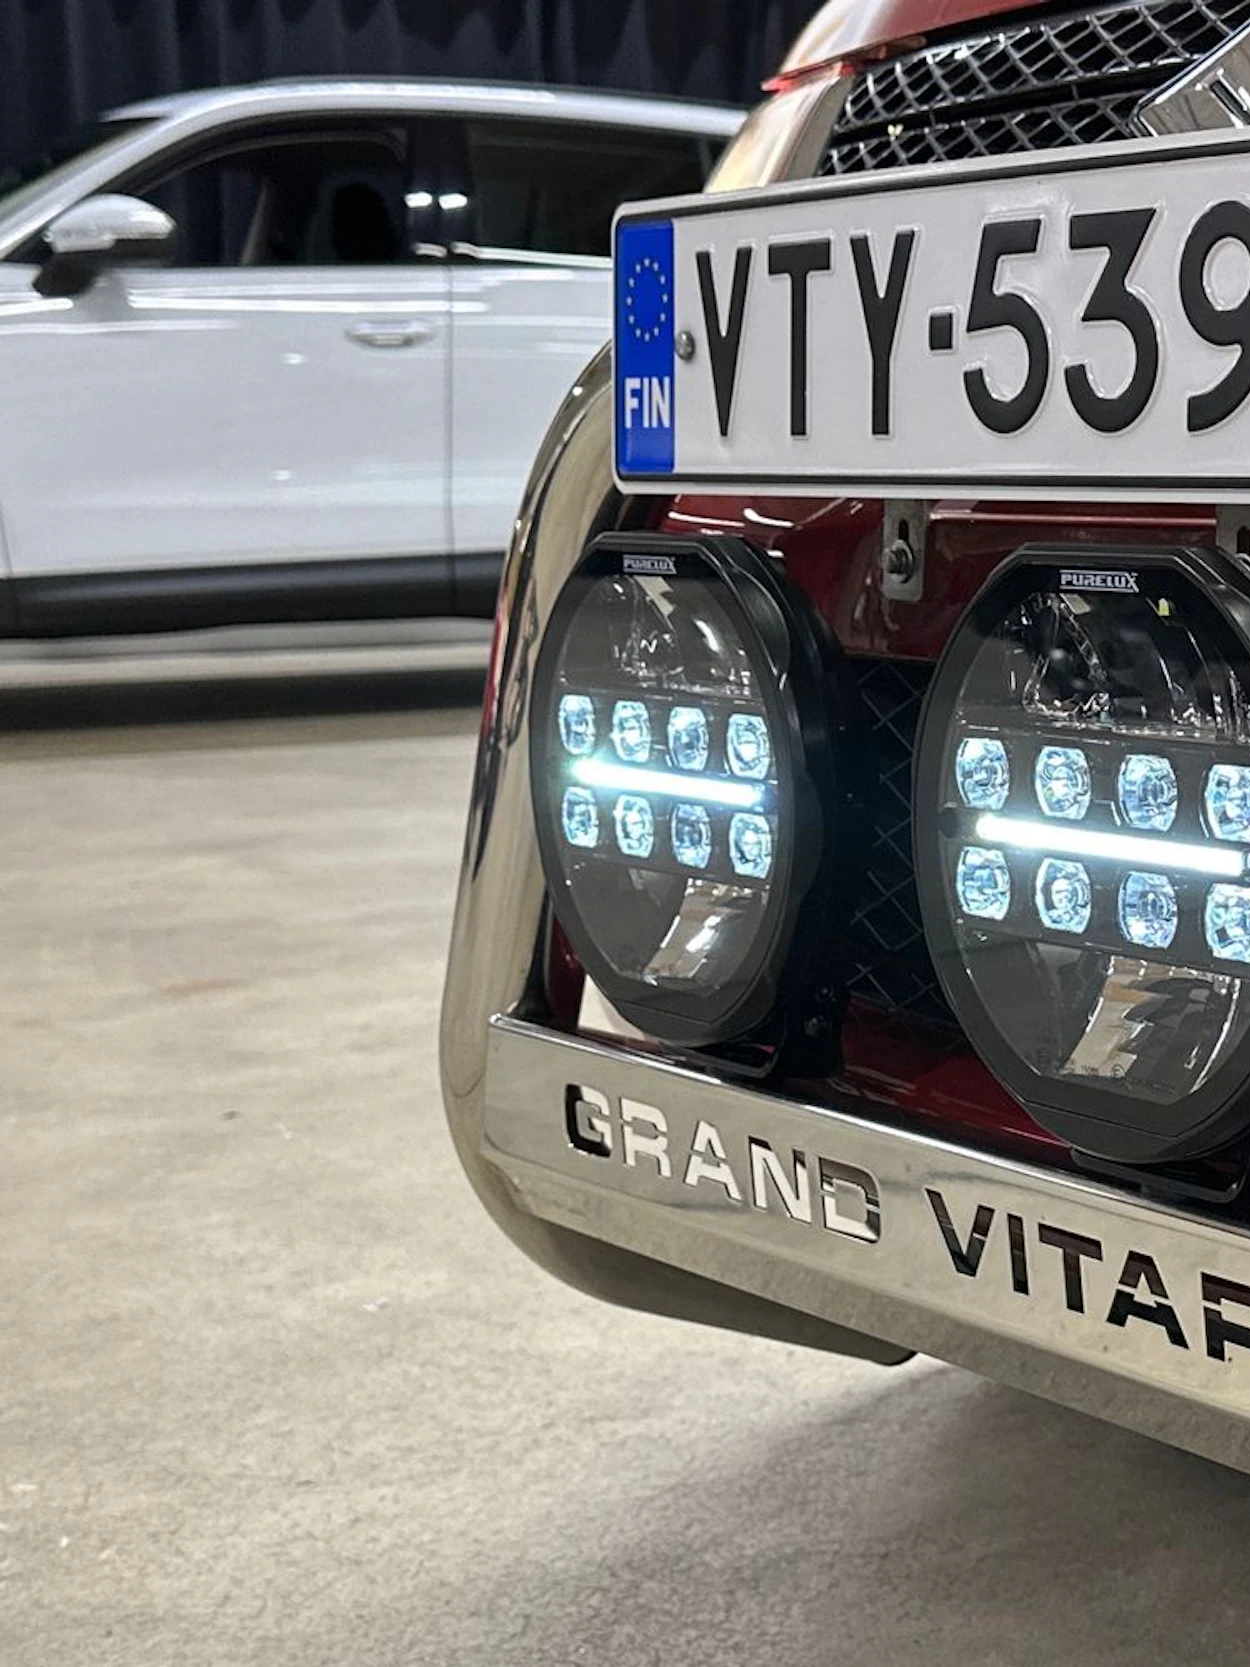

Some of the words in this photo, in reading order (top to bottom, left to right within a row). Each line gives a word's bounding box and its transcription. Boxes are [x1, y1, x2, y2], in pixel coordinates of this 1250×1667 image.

[625, 376, 670, 428] FIN
[1060, 572, 1139, 593] PURELUX
[564, 1083, 881, 1245] GRAND
